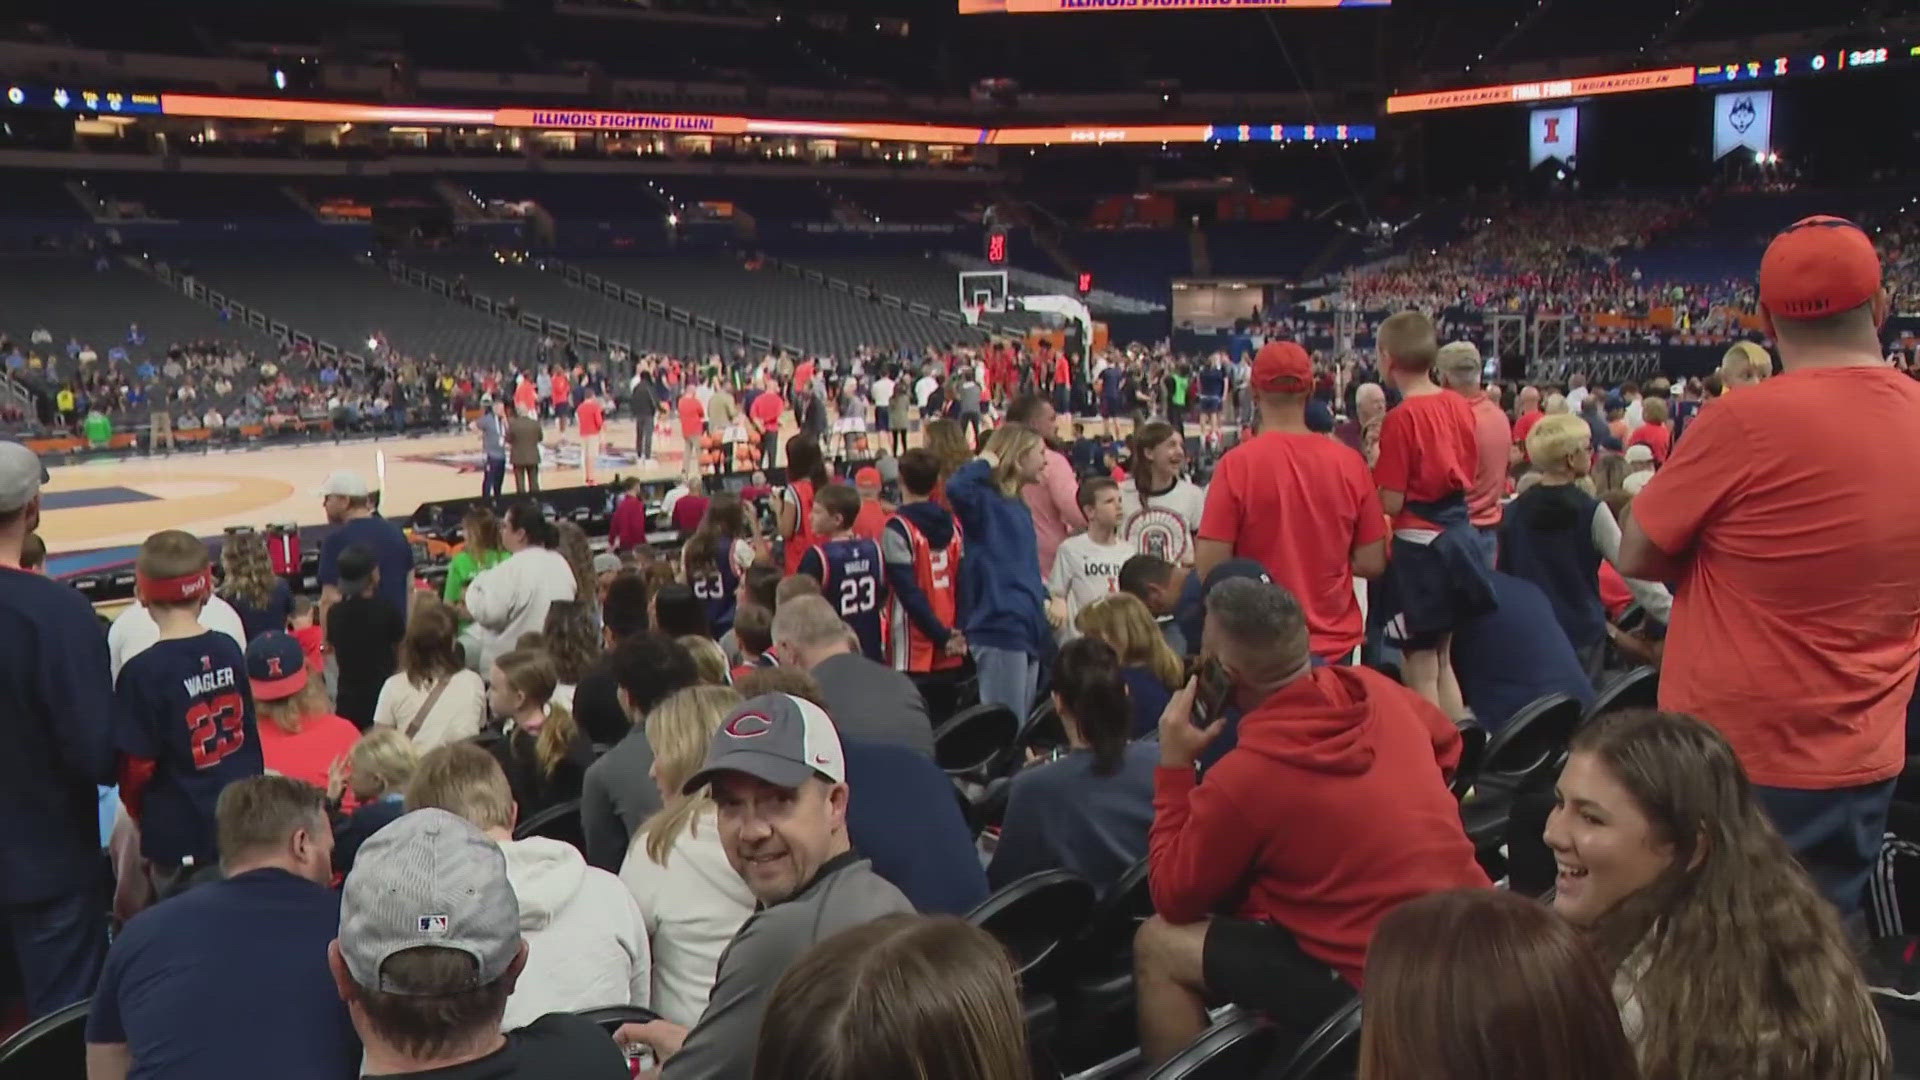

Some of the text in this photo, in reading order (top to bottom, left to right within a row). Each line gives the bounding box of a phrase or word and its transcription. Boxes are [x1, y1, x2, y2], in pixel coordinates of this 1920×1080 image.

[1812, 55, 1825, 70] 0
[1849, 48, 1888, 66] 3:22
[8, 87, 24, 104] 0
[1513, 83, 1541, 100] FINAL
[1543, 80, 1573, 98] FOUR
[533, 112, 714, 131] ILLINOIS FIGHTING ILLINI
[1543, 118, 1560, 143] I
[1084, 563, 1111, 576] LOCK
[840, 576, 875, 616] 23
[267, 657, 283, 677] I
[183, 666, 235, 699] WAGLER
[186, 692, 244, 771] 23
[724, 709, 772, 738] C
